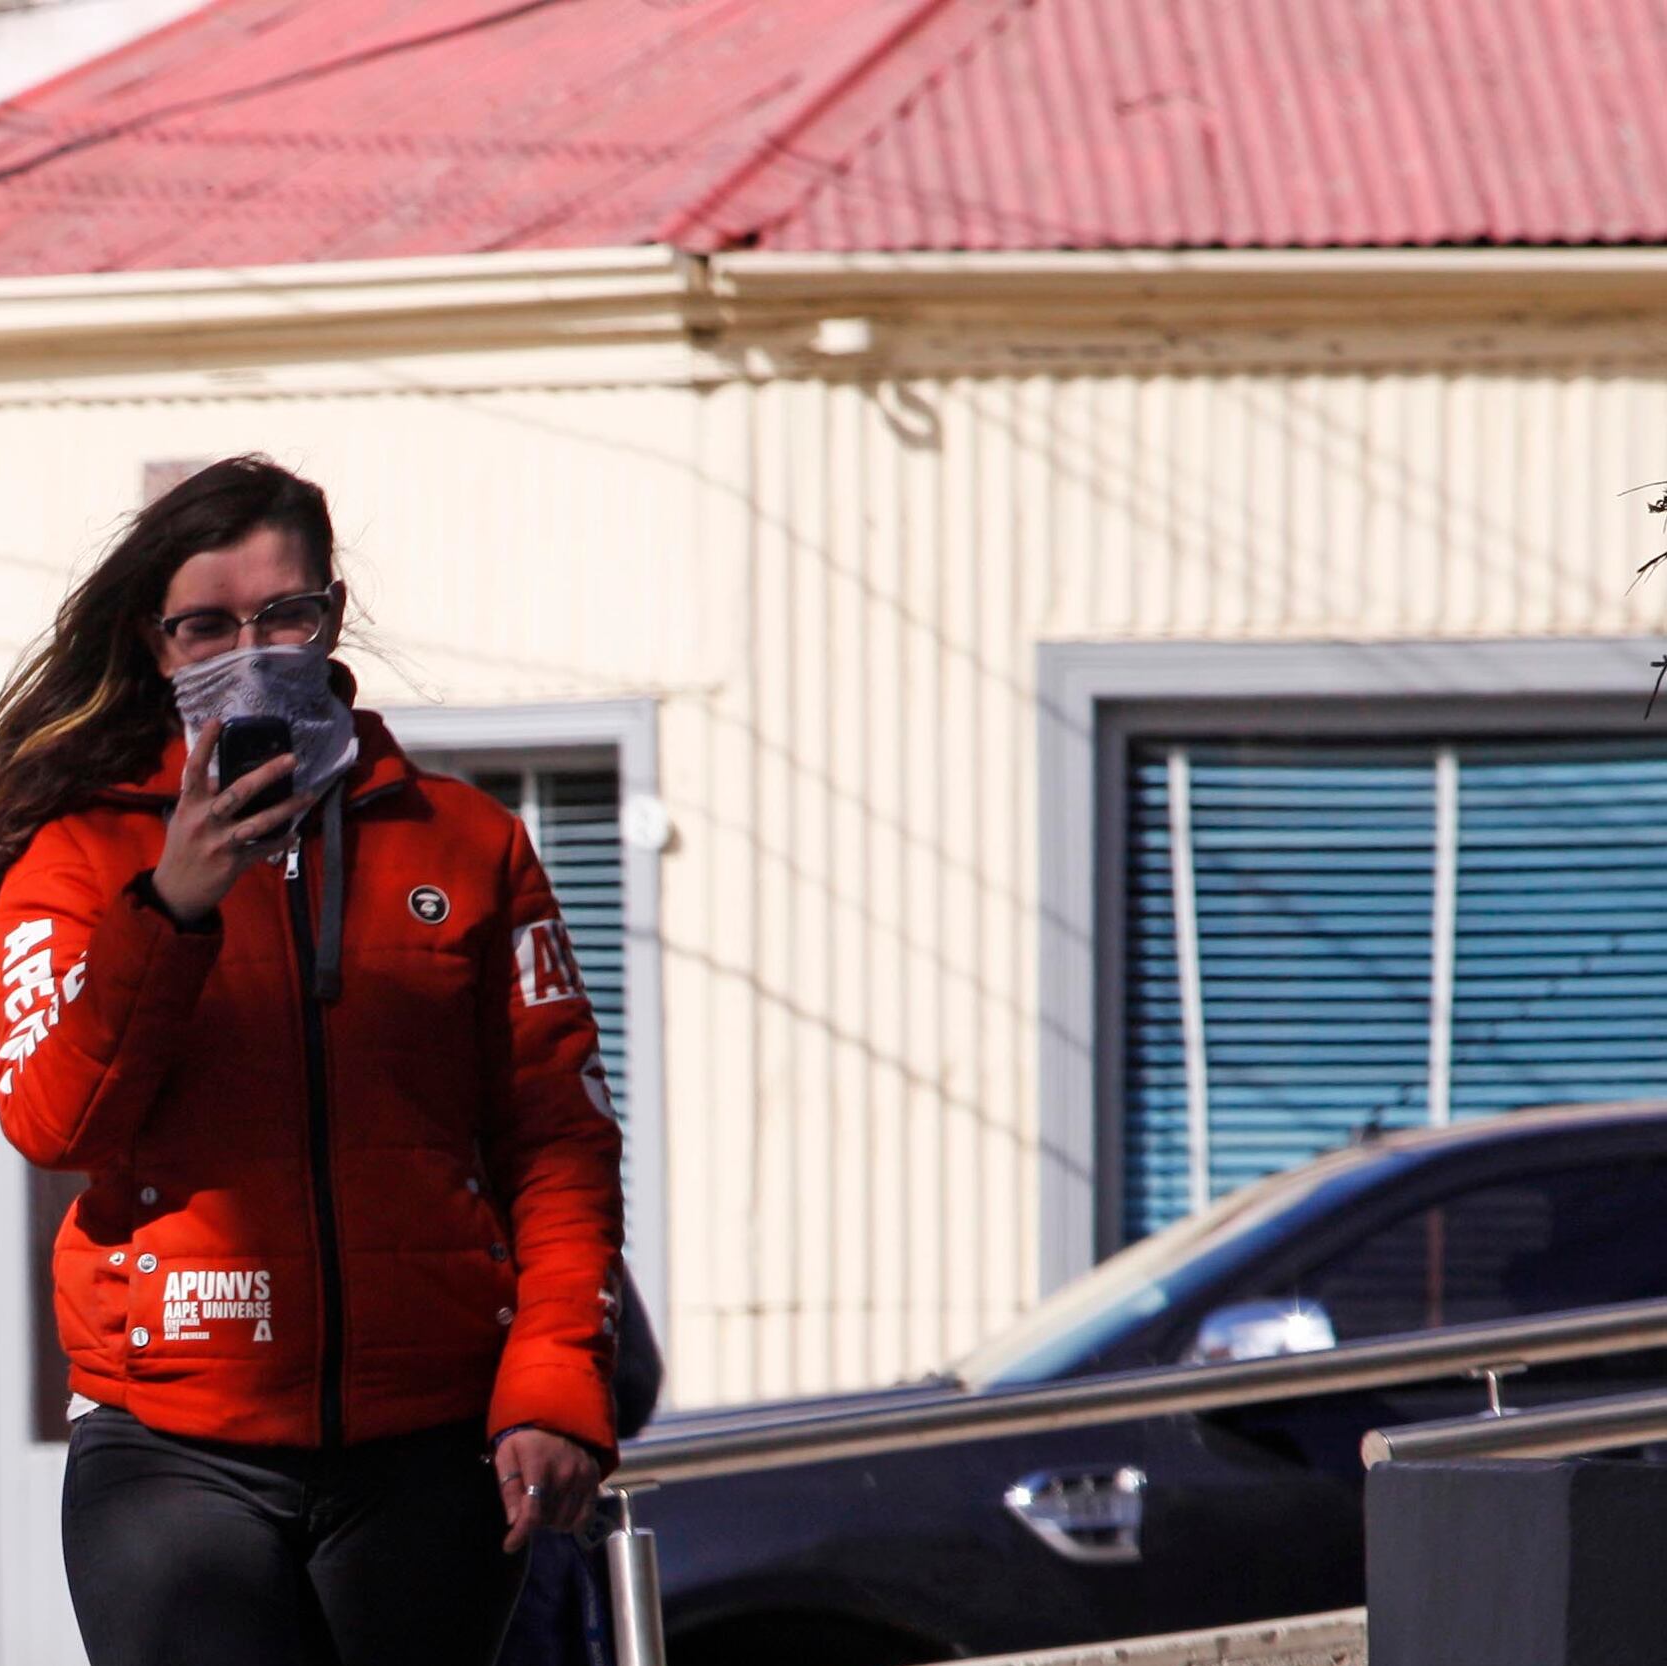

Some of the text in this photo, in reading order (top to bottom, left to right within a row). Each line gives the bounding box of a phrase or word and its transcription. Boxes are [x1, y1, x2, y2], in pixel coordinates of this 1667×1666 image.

[164, 1270, 271, 1301] APUNVS
[164, 1301, 272, 1319] AAPE UNIVERSE
